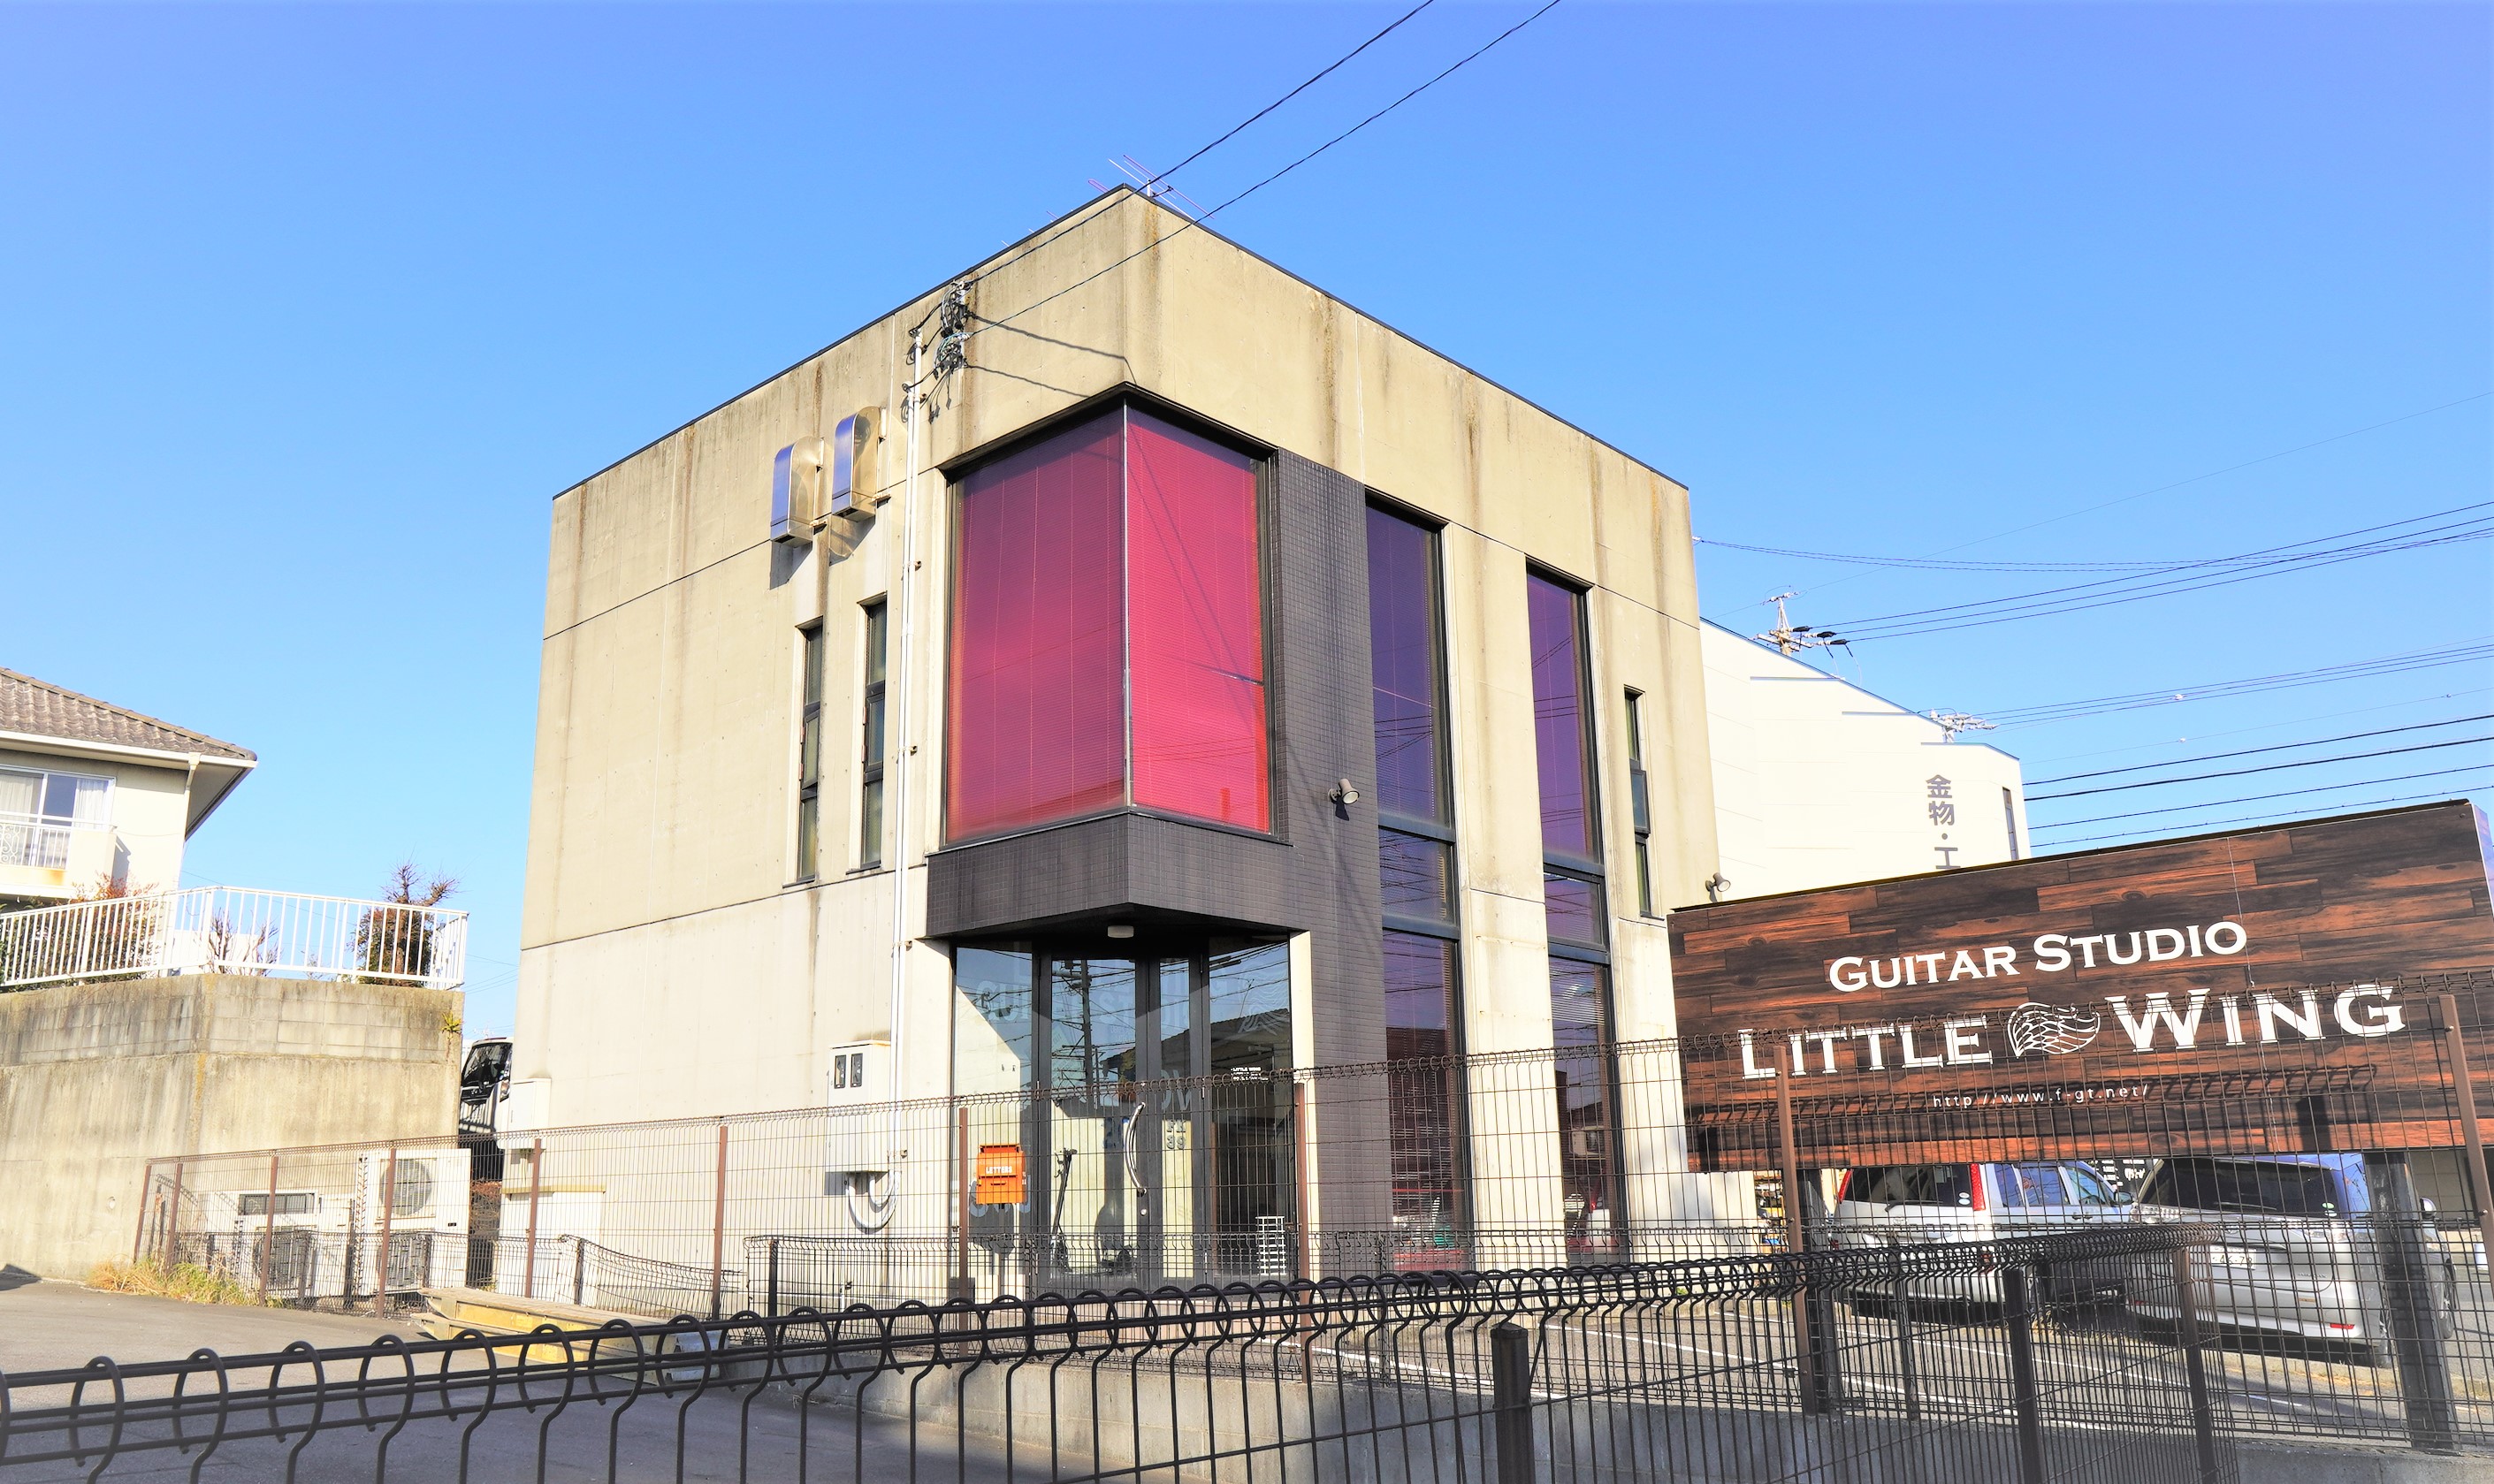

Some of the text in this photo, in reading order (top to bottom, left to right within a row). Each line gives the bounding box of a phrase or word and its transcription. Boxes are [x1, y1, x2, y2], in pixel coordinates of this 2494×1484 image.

[1828, 921, 2247, 993] GUITAR STUDIO
[1737, 984, 2406, 1080] LITTLE WING
[1933, 1084, 2149, 1109] http//www.f-gt.net/
[985, 1166, 1013, 1175] LETTERS
